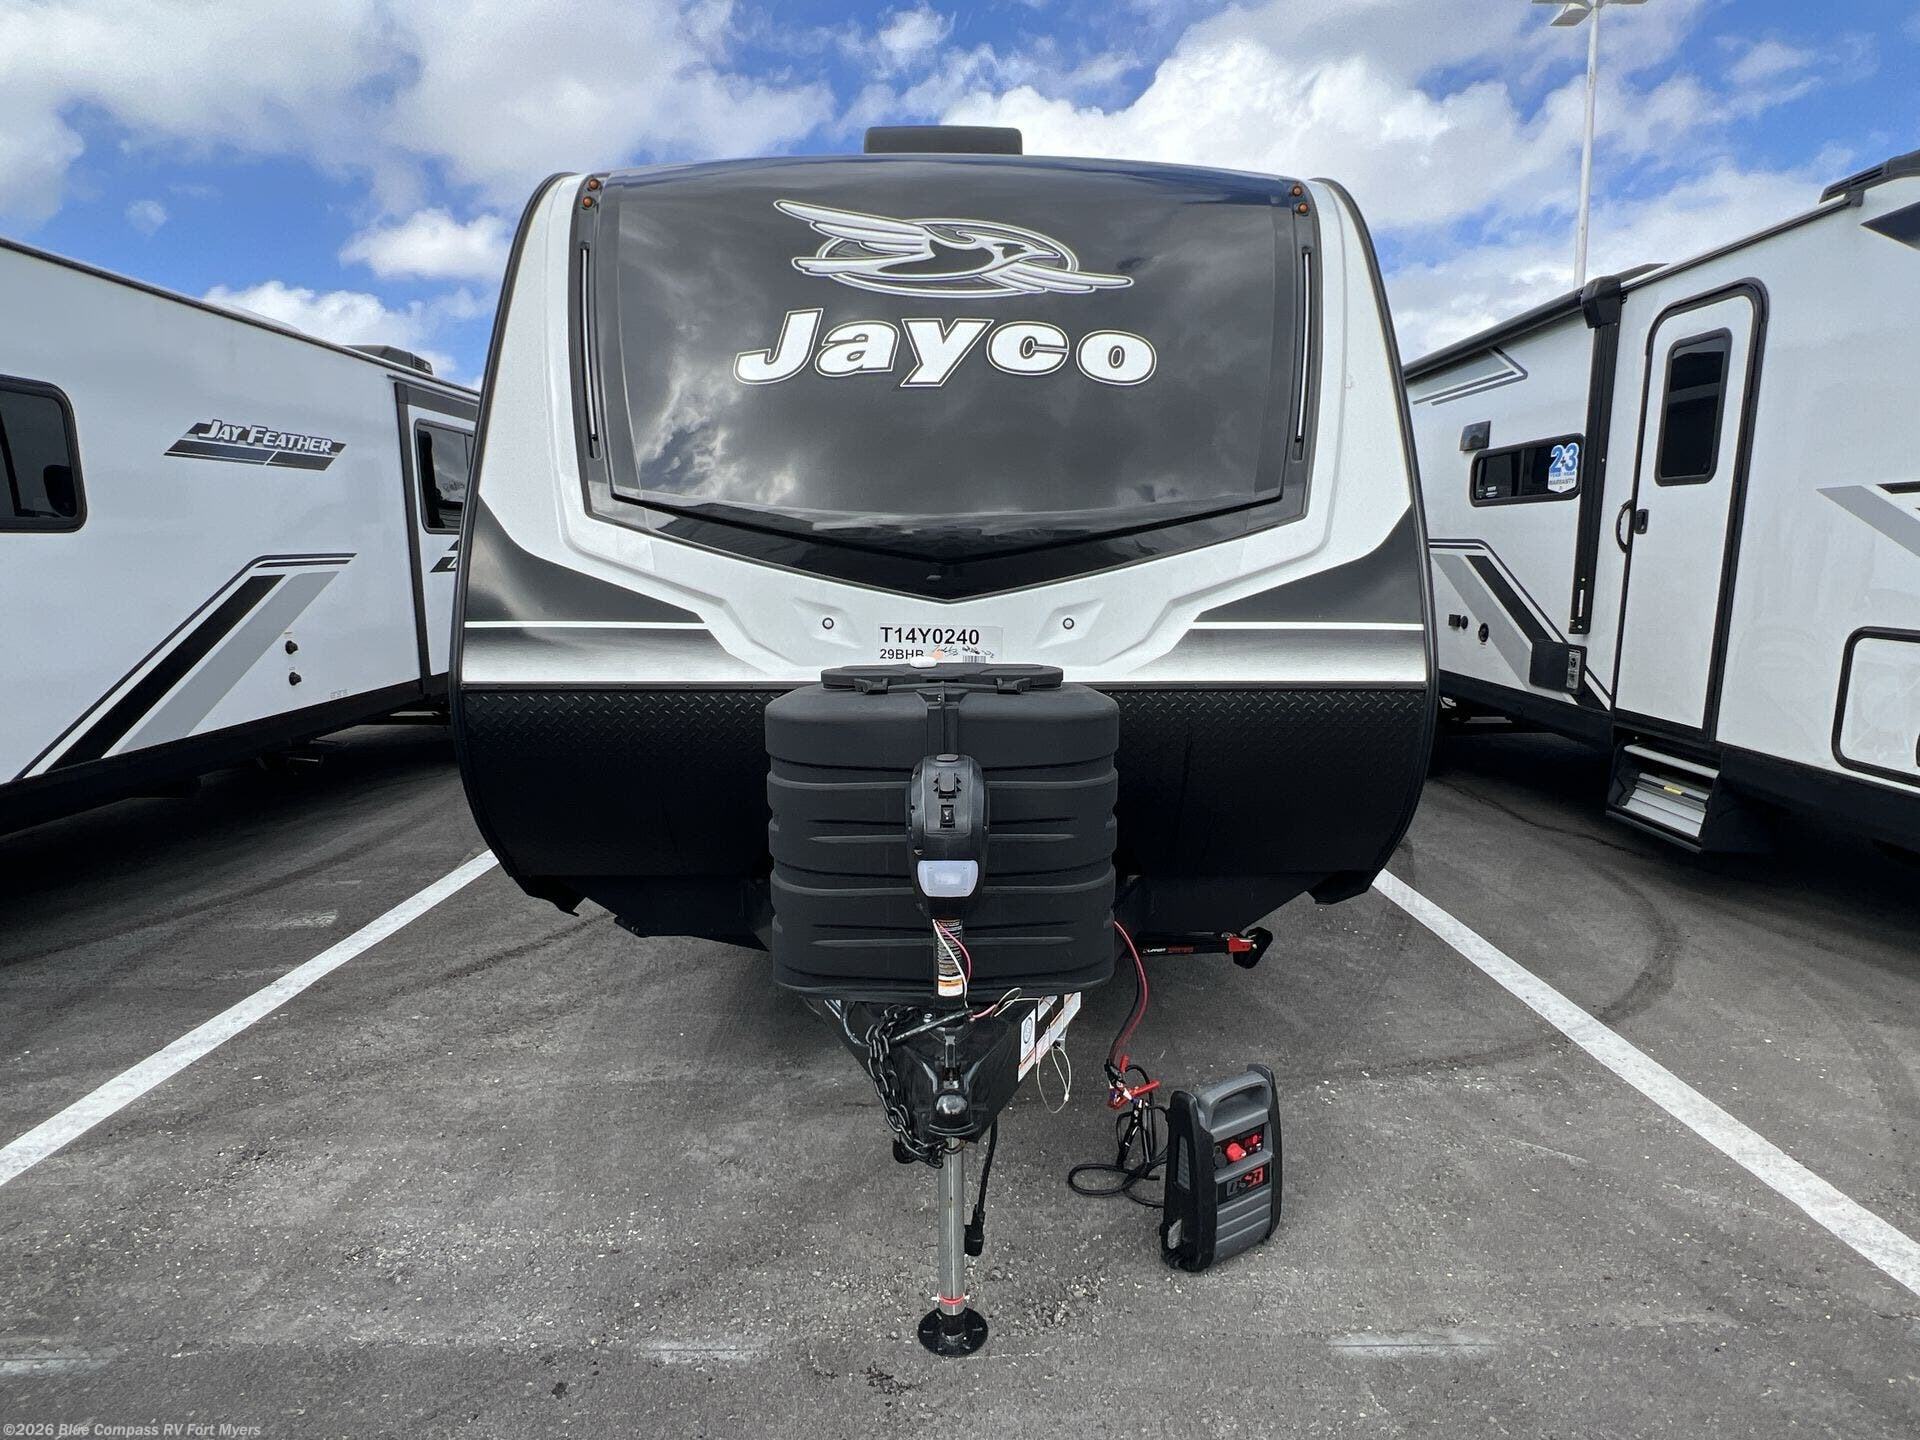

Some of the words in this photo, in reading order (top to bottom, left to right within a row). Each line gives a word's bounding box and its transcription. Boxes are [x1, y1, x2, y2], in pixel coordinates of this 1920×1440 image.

[733, 308, 1157, 387] Jayco
[198, 419, 244, 442] JAY
[247, 425, 333, 453] FEATHER
[880, 626, 980, 645] T14Y0240
